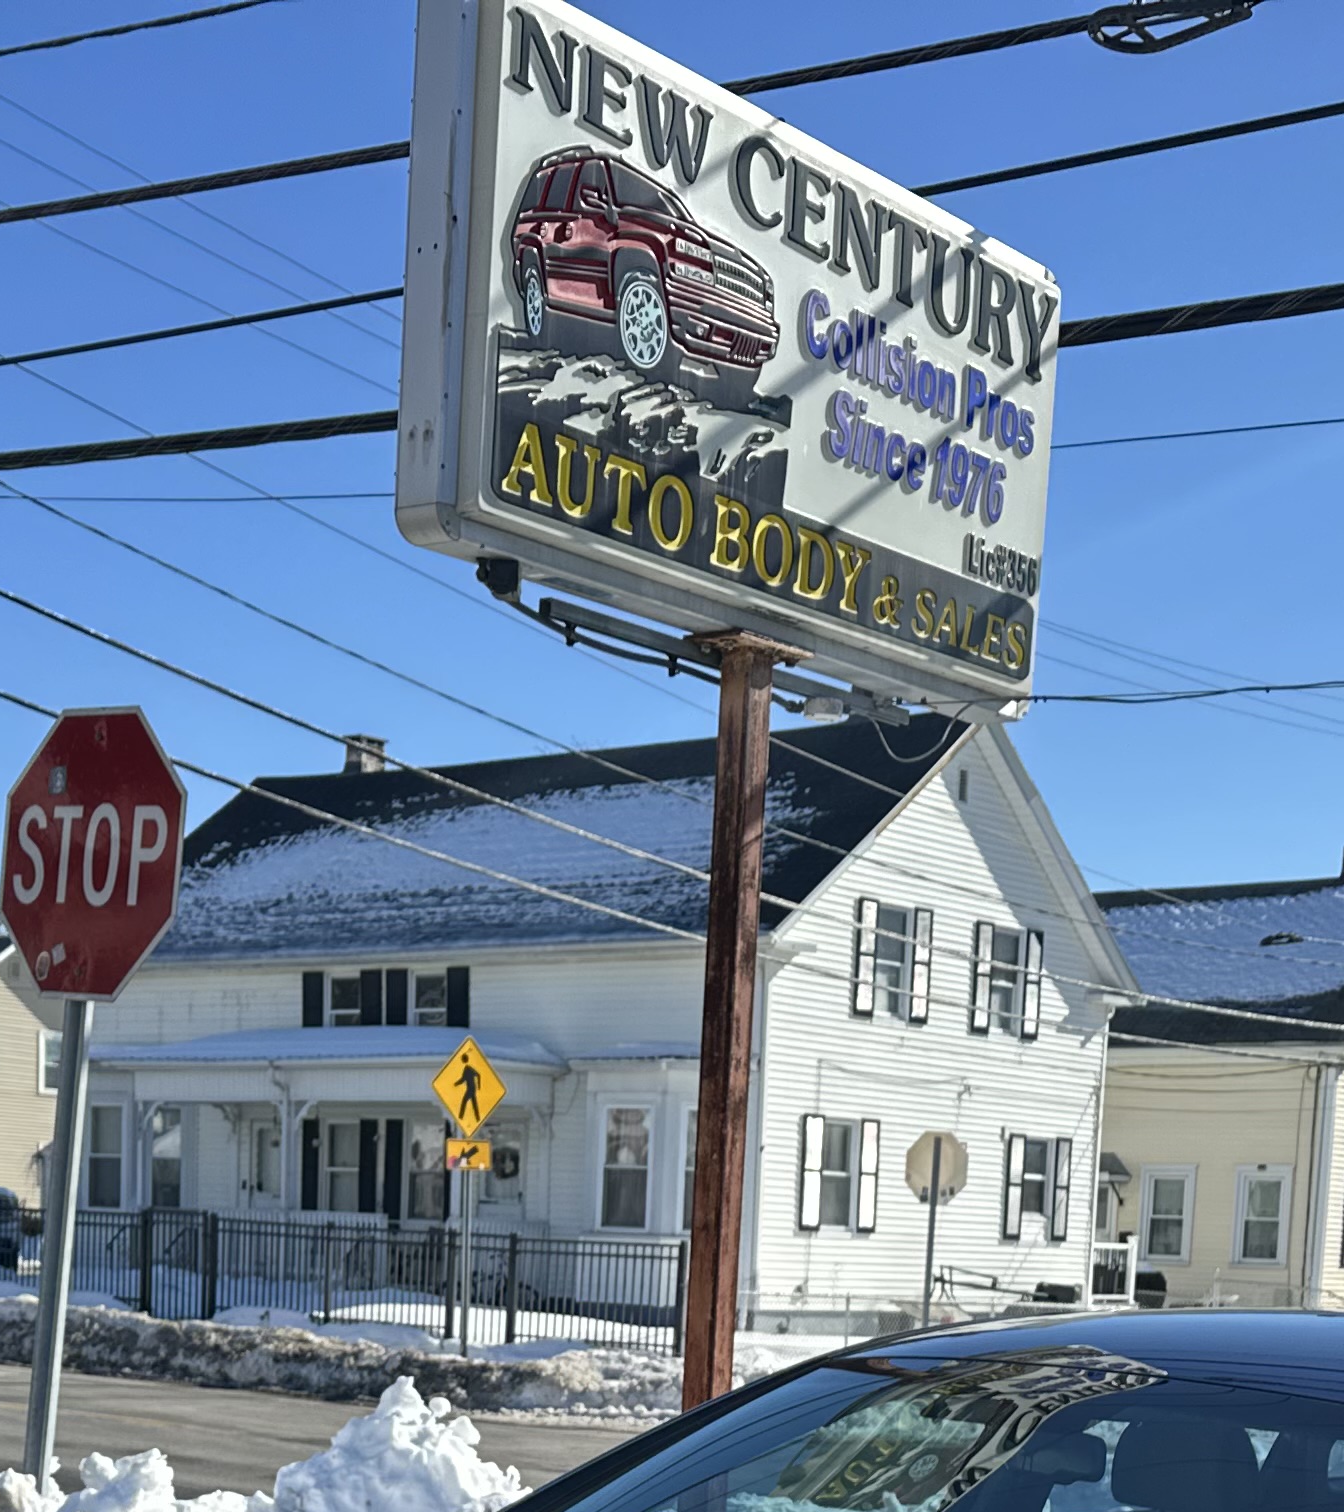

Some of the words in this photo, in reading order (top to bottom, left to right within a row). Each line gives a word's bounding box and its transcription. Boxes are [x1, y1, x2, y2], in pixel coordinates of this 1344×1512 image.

[506, 6, 713, 186] NEW
[731, 135, 1058, 382] CENTURY
[803, 288, 956, 419] Collision
[965, 362, 1036, 457] Pros
[828, 389, 925, 492] Since
[935, 437, 1007, 524] 1976
[501, 424, 695, 553] AUTO
[710, 493, 872, 614] BODY
[872, 574, 903, 628] &
[911, 588, 1026, 670] SALES
[12, 802, 169, 908] STOP
